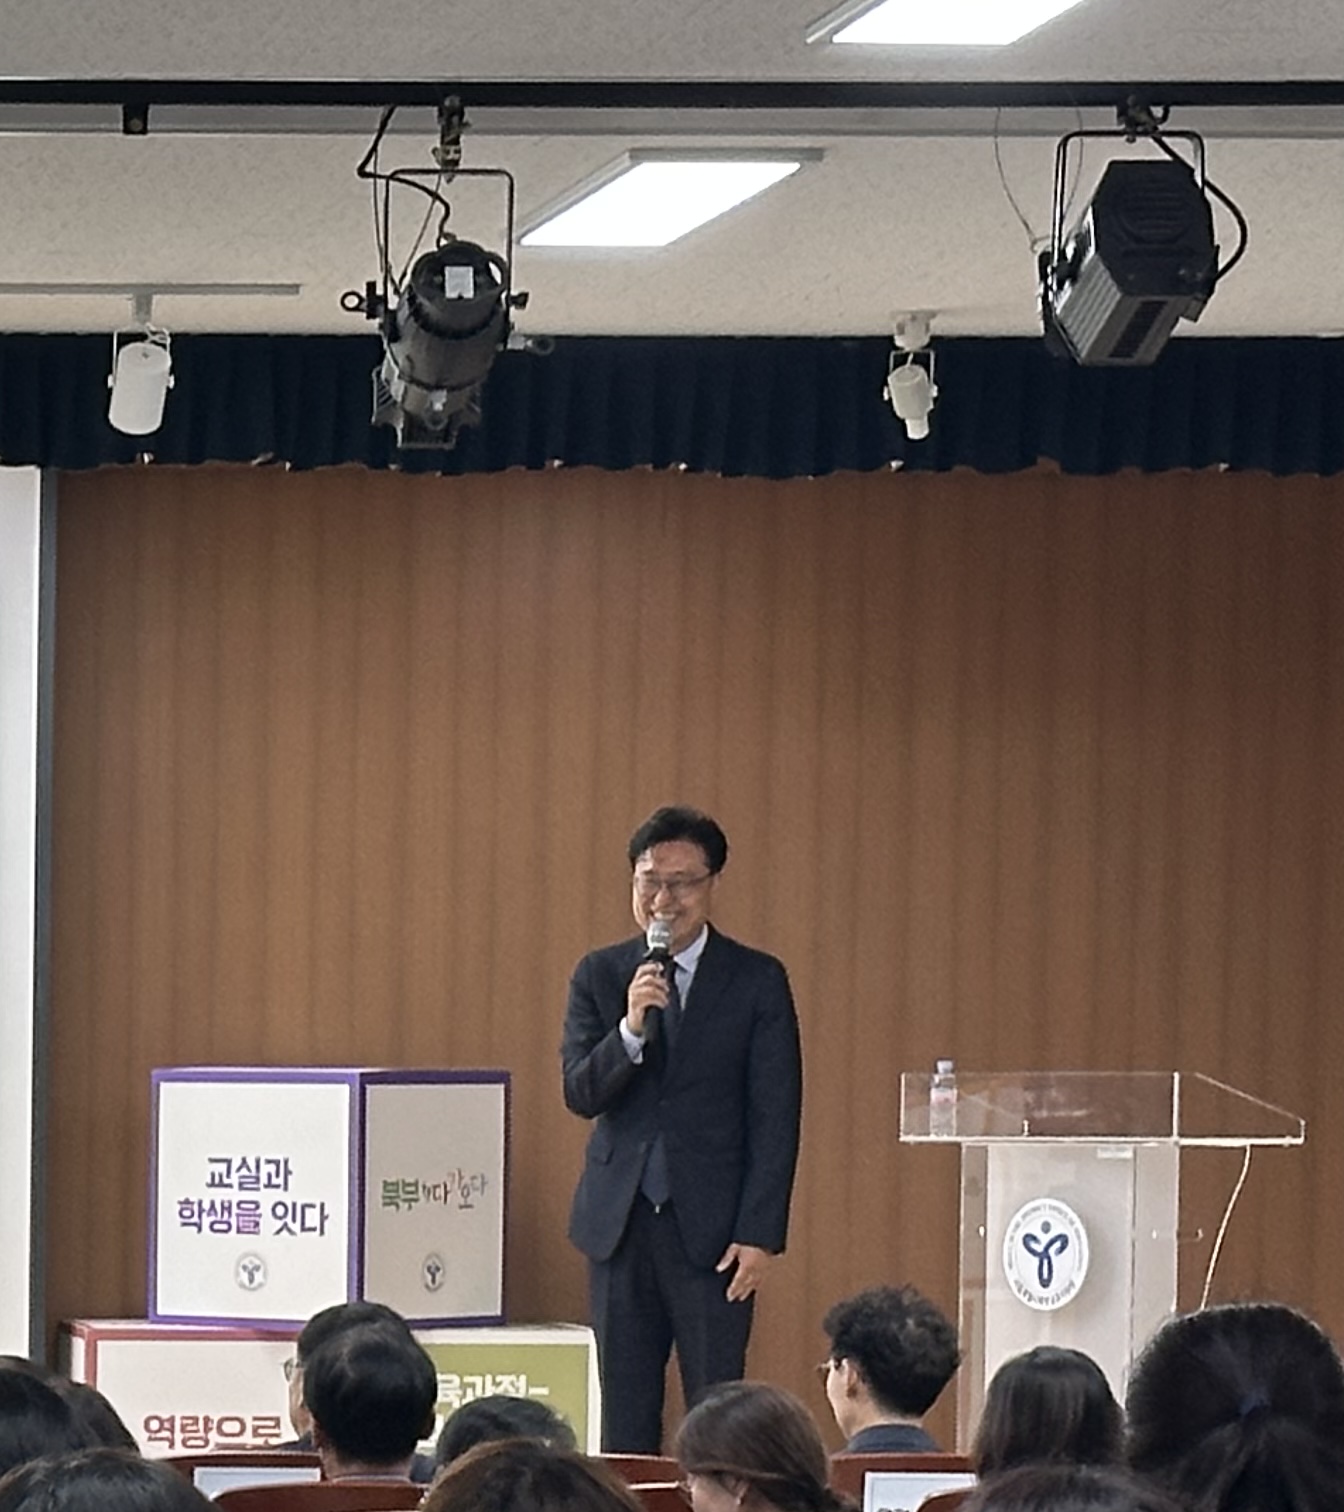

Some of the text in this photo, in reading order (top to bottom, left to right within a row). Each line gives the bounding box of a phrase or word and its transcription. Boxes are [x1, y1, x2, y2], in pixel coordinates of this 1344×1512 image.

[205, 1156, 293, 1192] 교실과
[381, 1178, 421, 1212] 북부
[177, 1197, 330, 1238] 학생을 잇다
[143, 1415, 282, 1450] 역량으로
